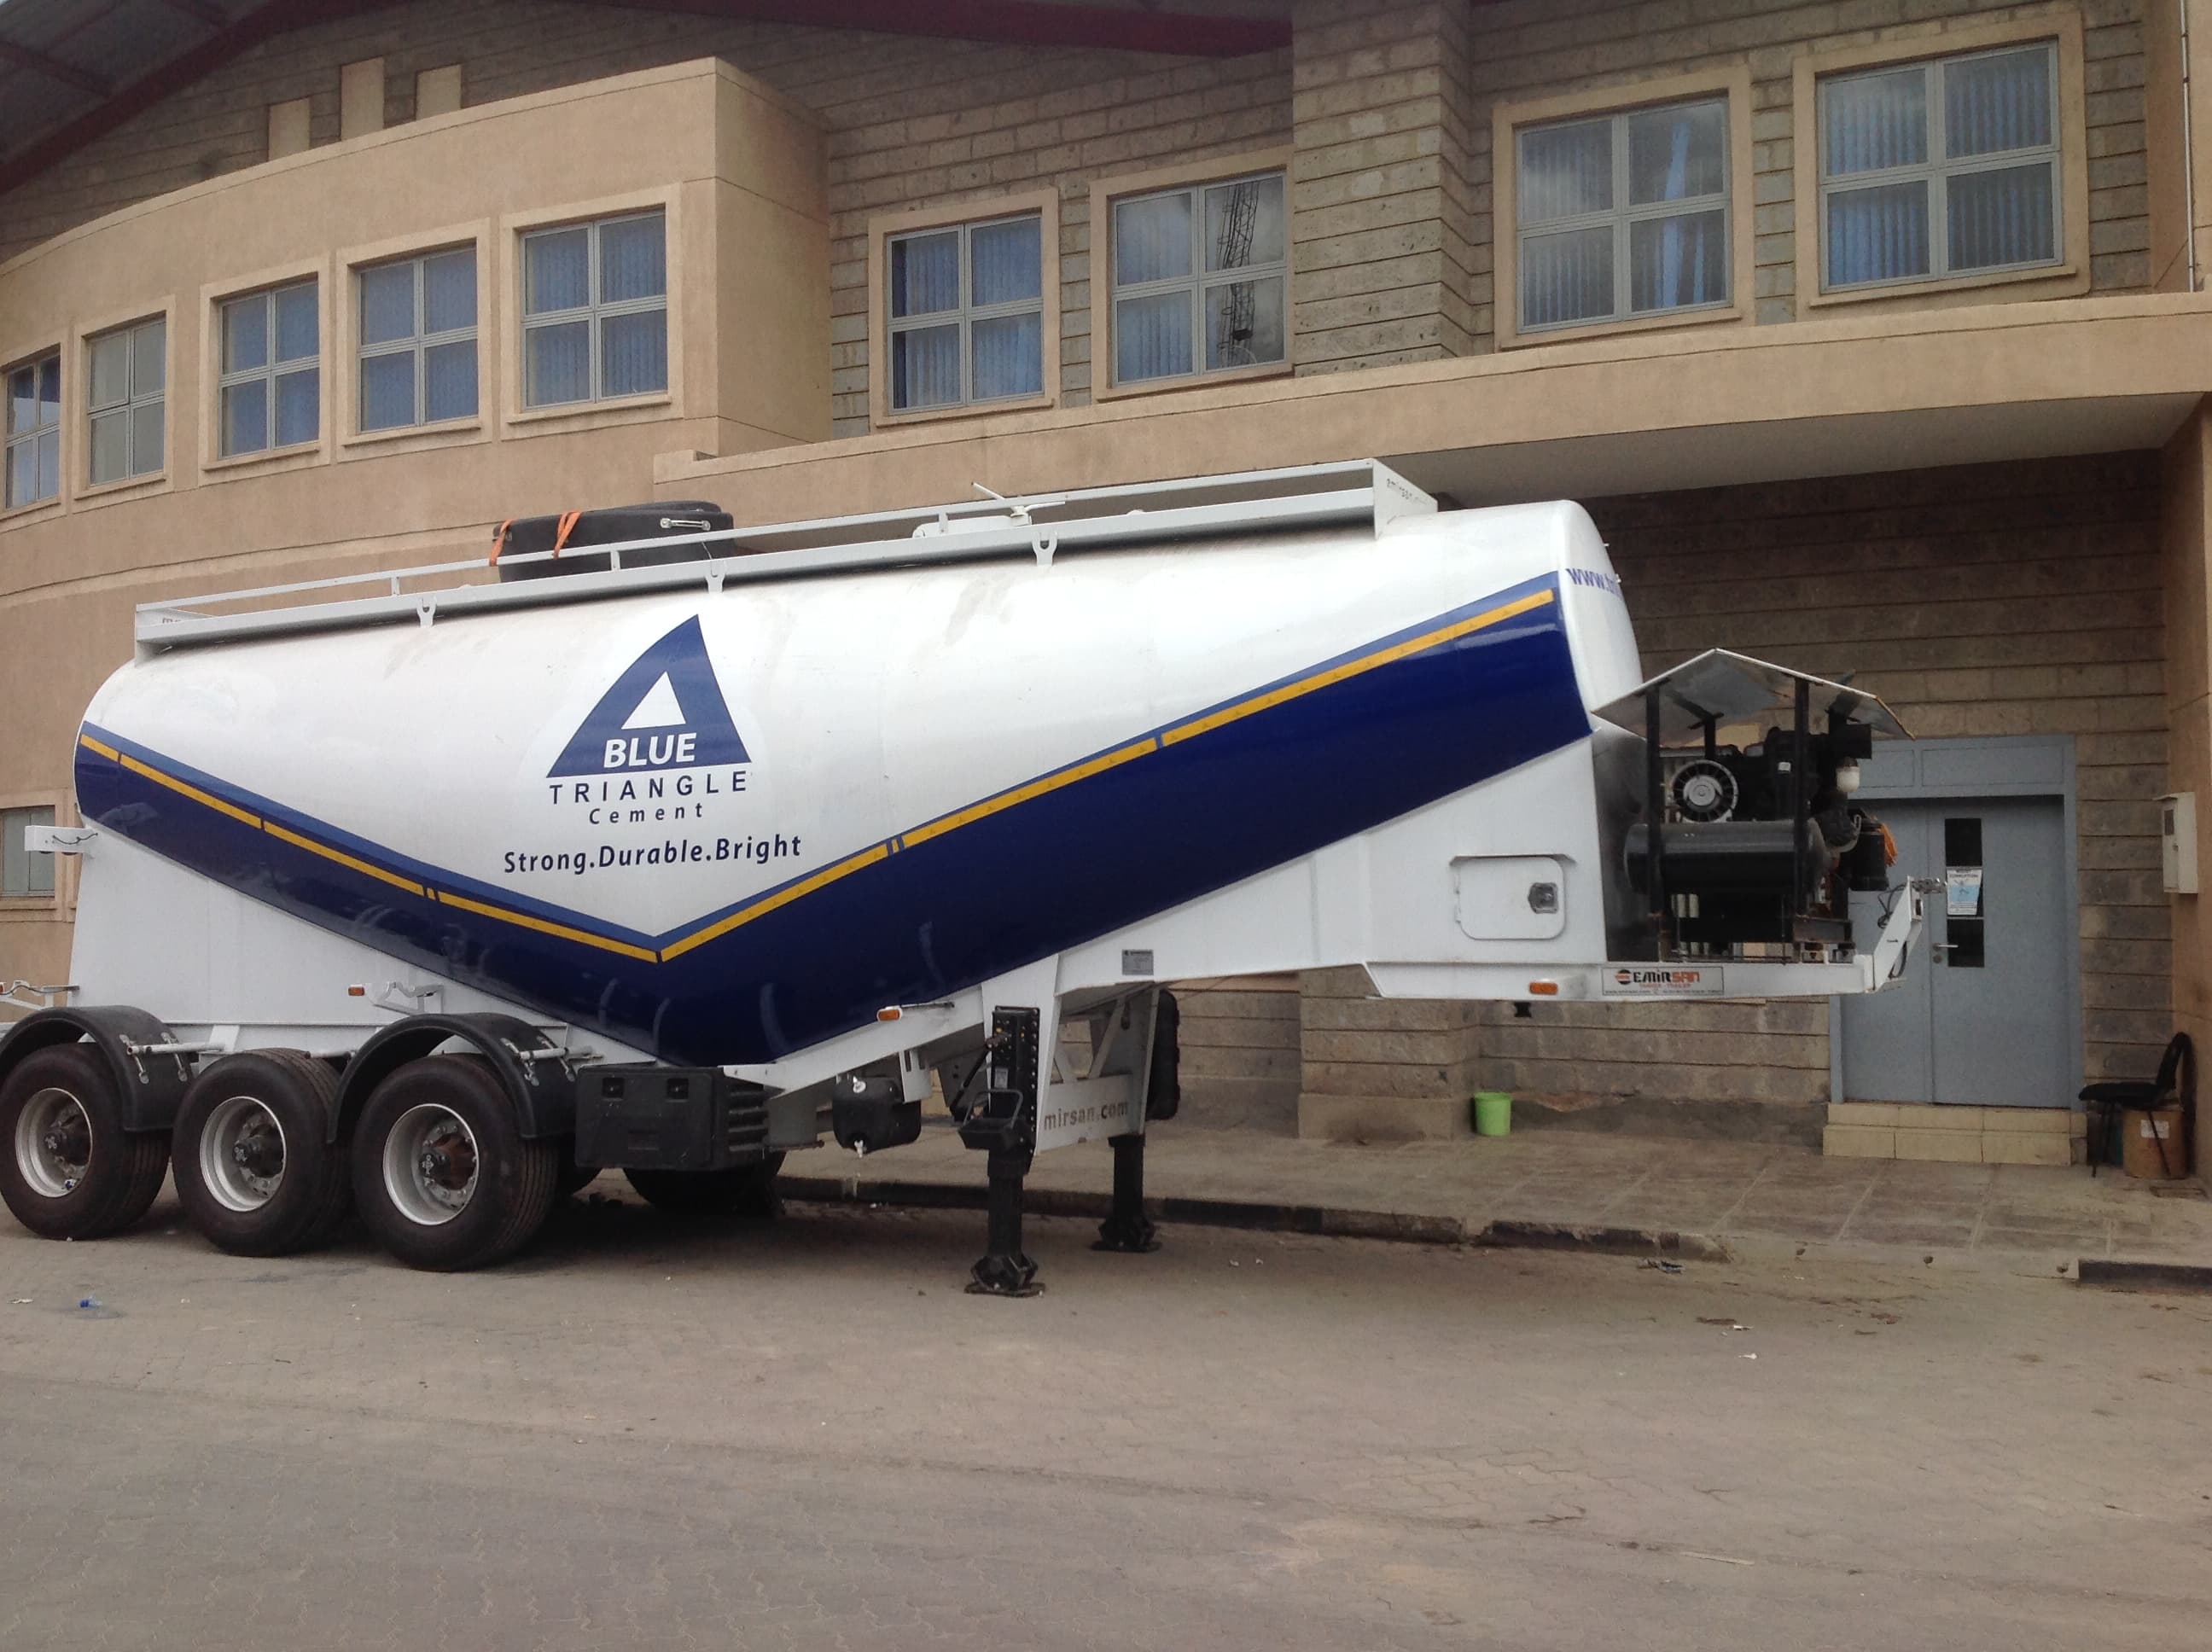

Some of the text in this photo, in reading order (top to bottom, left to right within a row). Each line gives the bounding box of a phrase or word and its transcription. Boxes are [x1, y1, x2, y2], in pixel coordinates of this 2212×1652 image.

[603, 732, 697, 768] BLUE
[549, 770, 748, 805] TRIANGLE
[589, 802, 703, 824] Cement
[504, 834, 801, 875] Strong.Durable.Bright
